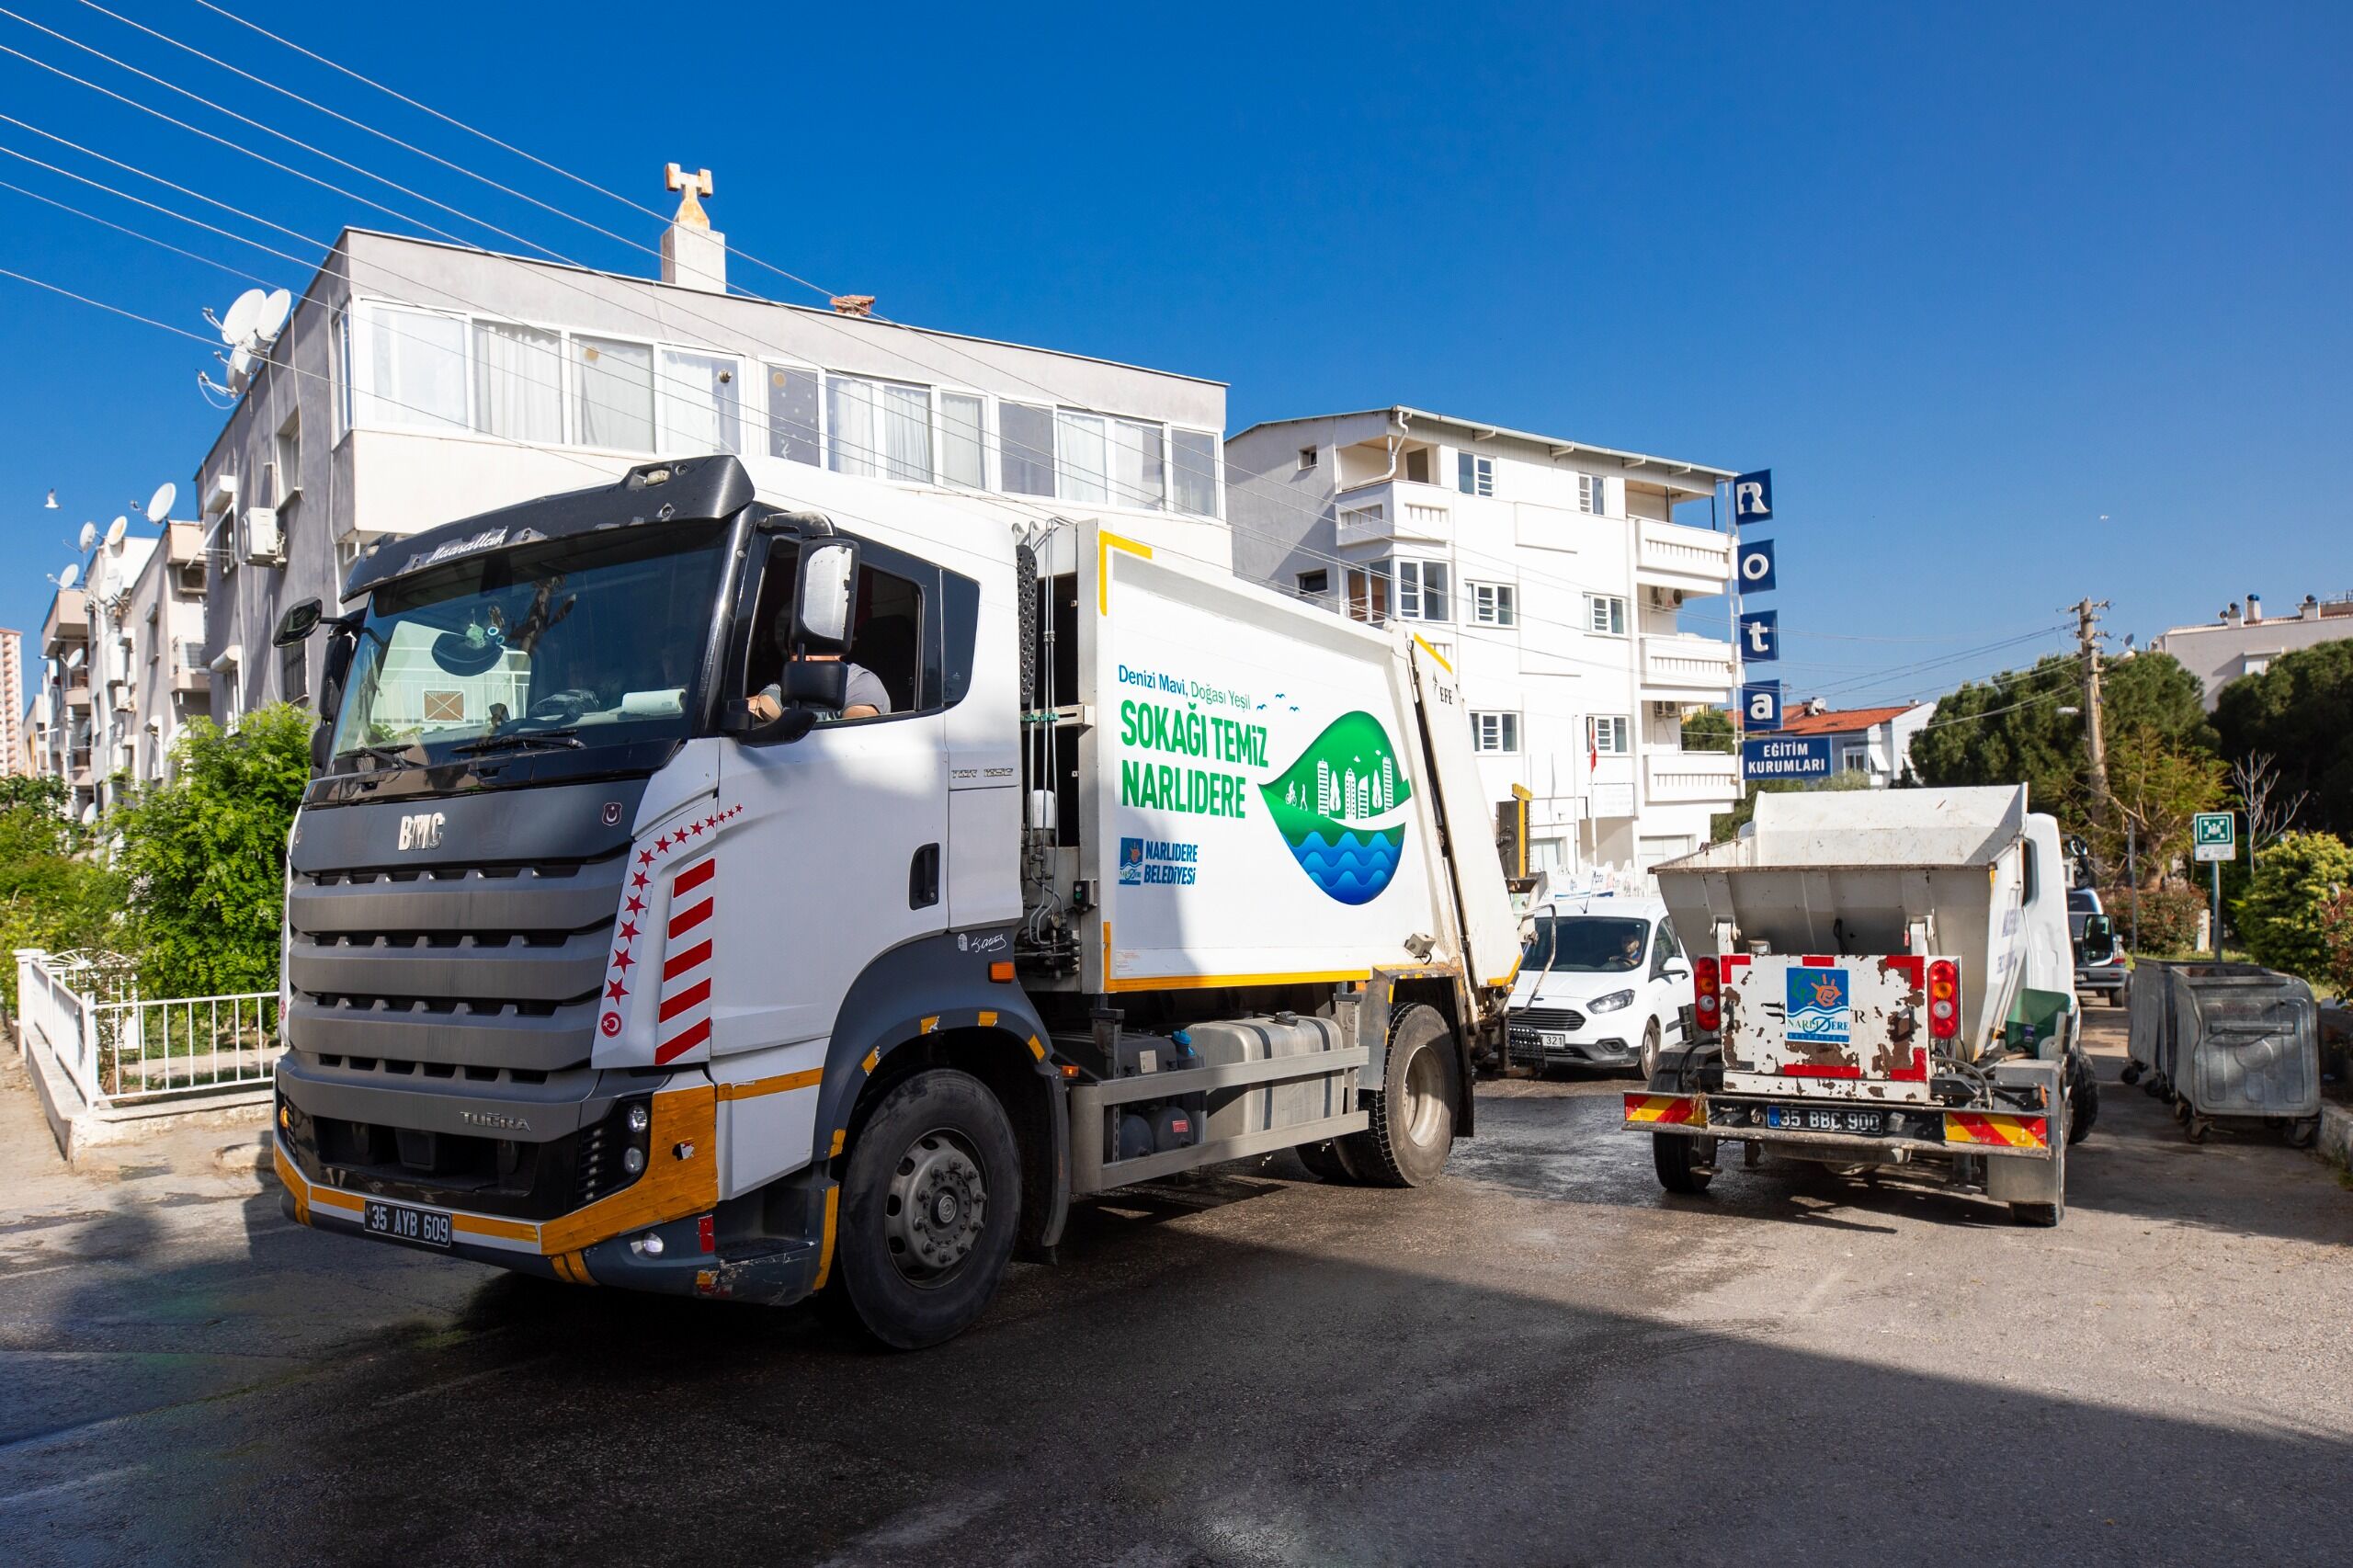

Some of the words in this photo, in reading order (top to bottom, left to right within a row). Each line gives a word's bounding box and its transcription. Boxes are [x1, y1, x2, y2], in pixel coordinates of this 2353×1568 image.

[1119, 664, 1155, 689] Denizi
[1159, 673, 1188, 699] Mavi,
[1190, 680, 1226, 705] Doğası
[1228, 689, 1251, 713] Yeşil
[1439, 686, 1453, 705] EFE
[1120, 699, 1208, 758] SOKAĞI
[1211, 717, 1268, 767] TEMİZ
[1763, 741, 1808, 757] EĞİTİM
[1748, 758, 1825, 774] KURUMLARI
[1121, 759, 1246, 819] NARLIDERE
[398, 812, 446, 851] BMC
[1145, 840, 1199, 863] NARLIDERE
[1143, 864, 1197, 885] BELEDİYESİ
[1546, 1036, 1563, 1045] 321
[1780, 1109, 1801, 1127] 35
[1809, 1110, 1841, 1130] BBC
[1847, 1113, 1880, 1131] 900
[371, 1205, 387, 1231] 35
[394, 1209, 418, 1237] AYB
[424, 1214, 449, 1243] 609
